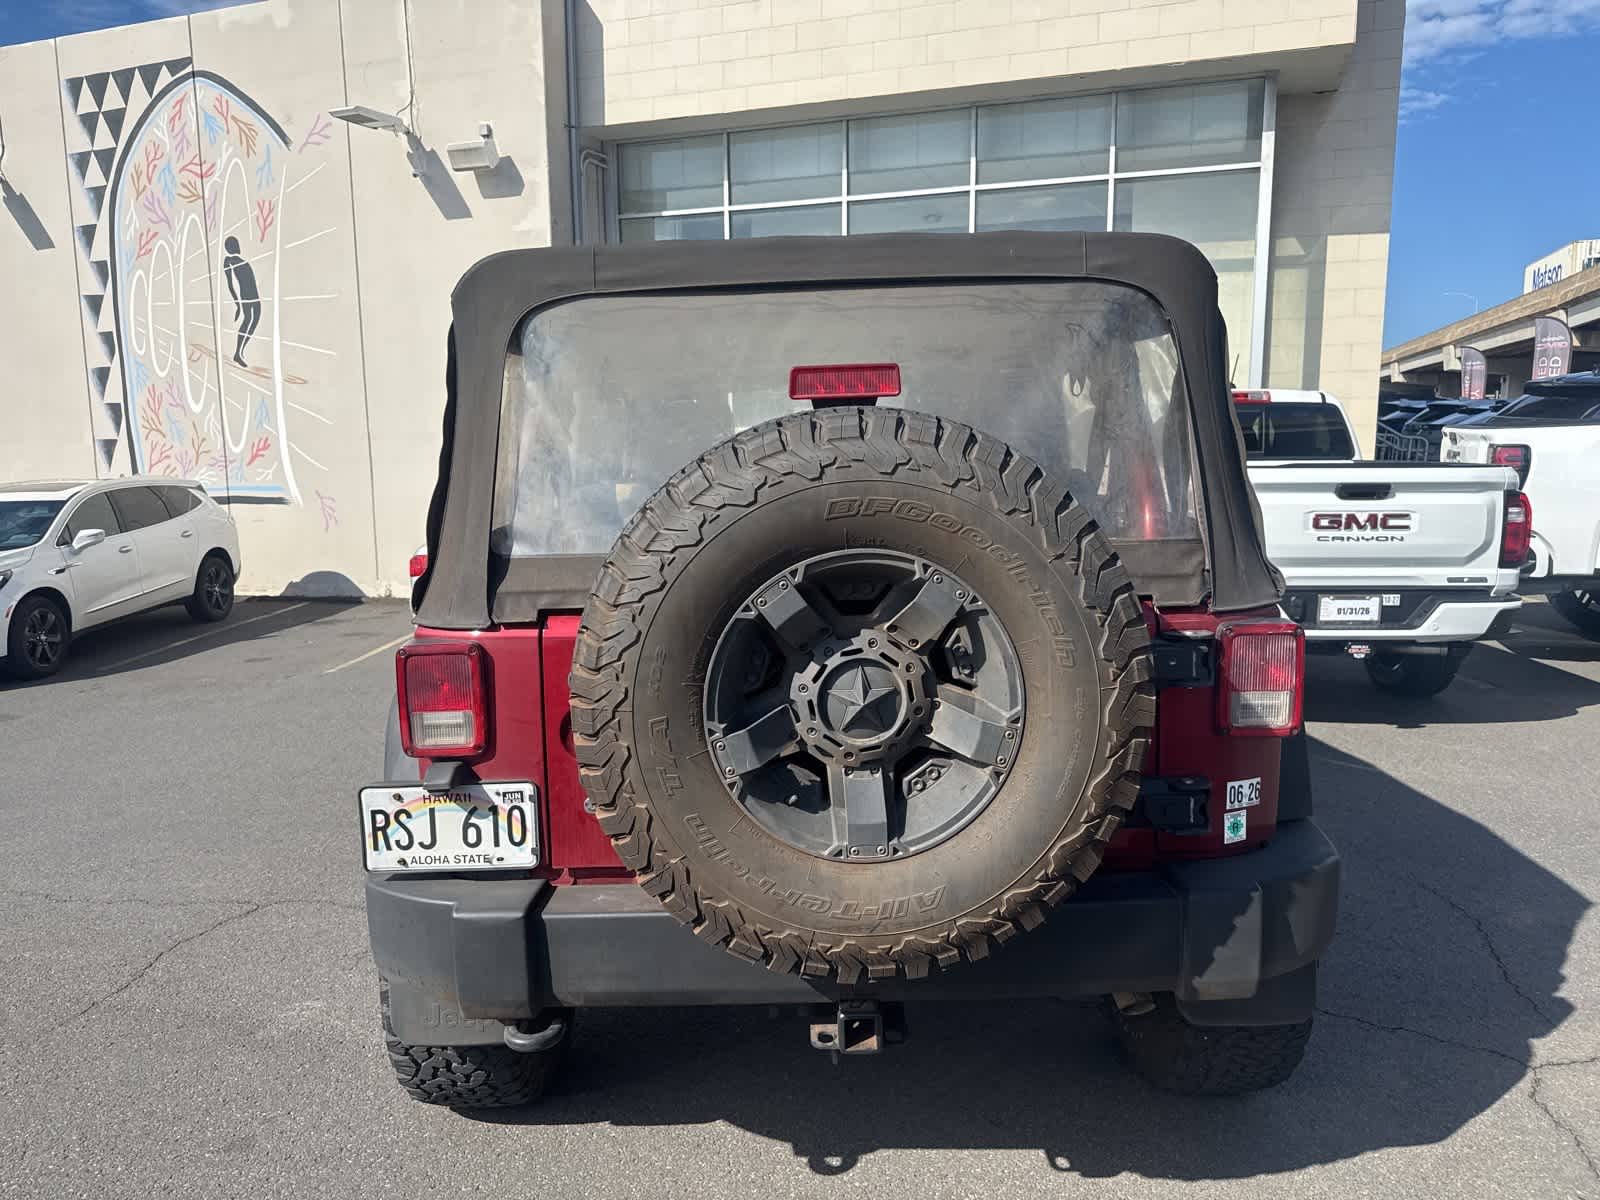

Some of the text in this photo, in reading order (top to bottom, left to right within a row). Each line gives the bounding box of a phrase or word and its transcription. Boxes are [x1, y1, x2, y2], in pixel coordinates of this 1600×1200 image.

[1532, 264, 1562, 289] Matson
[1312, 513, 1411, 531] GMC
[824, 496, 1077, 668] BFGoodrich
[422, 792, 472, 805] HAWAII
[503, 792, 521, 800] JUN
[1229, 781, 1260, 805] 06 26
[370, 805, 527, 851] RSJ 610
[410, 854, 490, 865] ALOHA STATE
